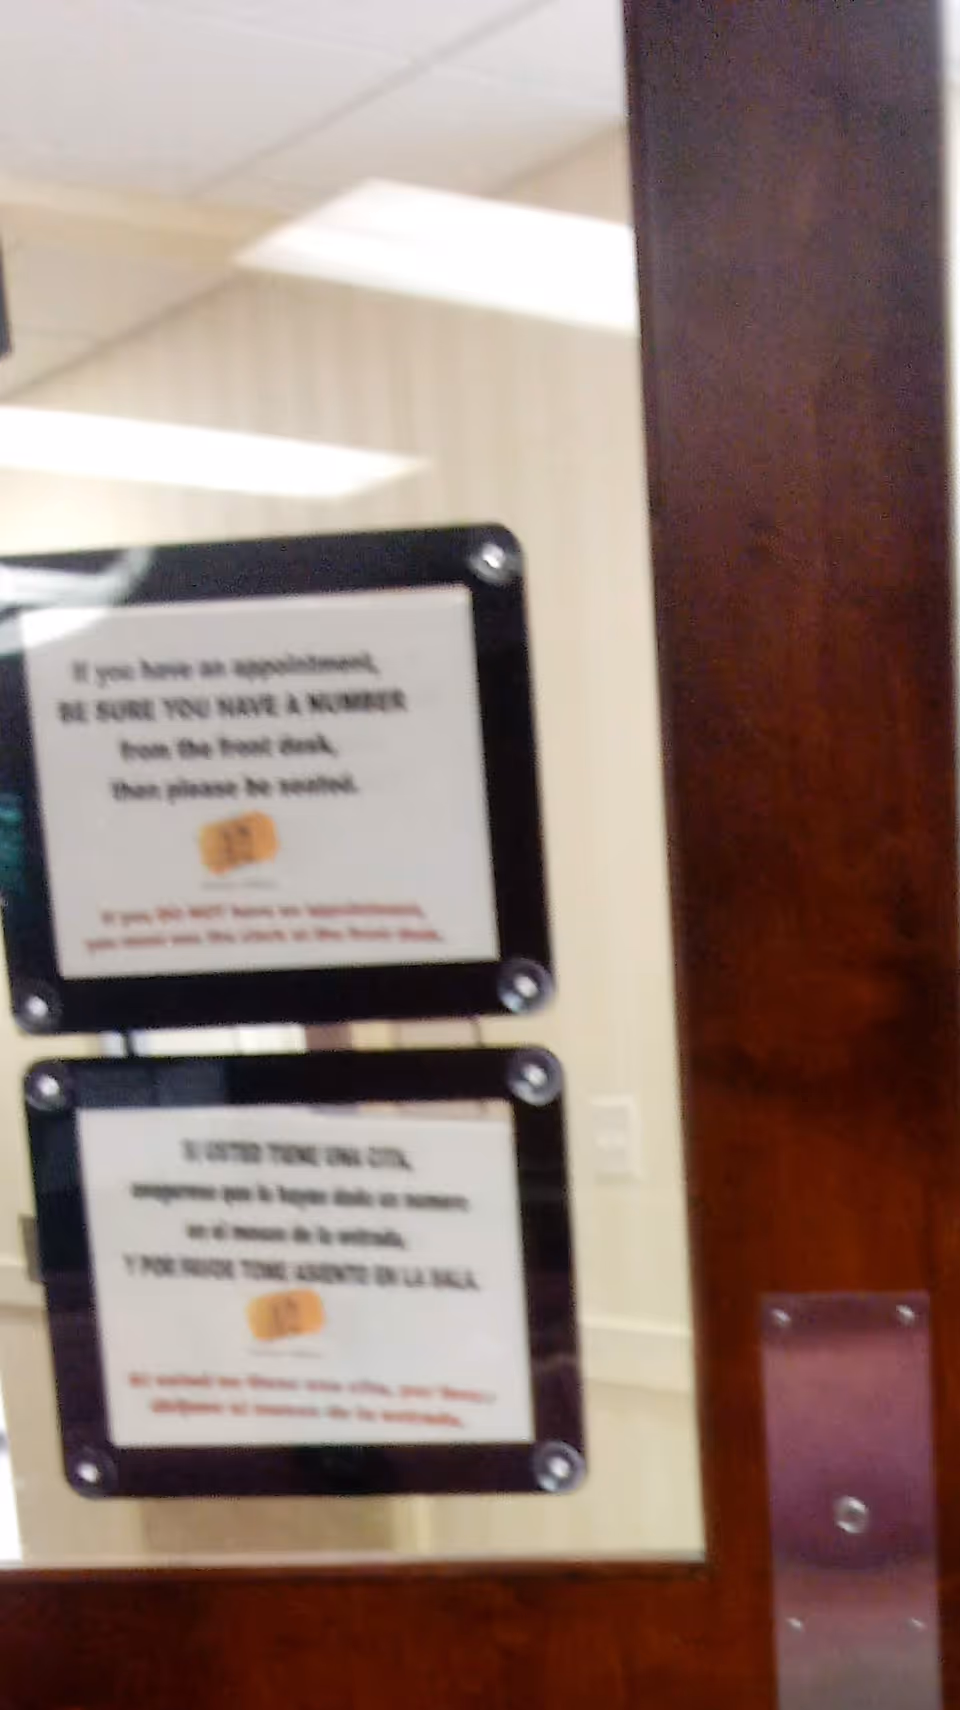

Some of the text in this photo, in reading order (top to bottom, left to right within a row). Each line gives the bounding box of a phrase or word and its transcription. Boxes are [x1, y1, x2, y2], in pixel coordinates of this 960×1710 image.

[96, 665, 134, 688] you
[138, 658, 192, 680] have
[200, 662, 226, 680] an
[231, 652, 380, 682] appointment,
[58, 688, 407, 724] BE SURE YOU HAVE A NUMBER
[120, 739, 171, 762] from
[176, 737, 212, 760] the
[217, 736, 272, 760] front
[112, 777, 161, 801] then
[166, 776, 239, 806] please
[243, 773, 271, 799] be
[183, 1139, 200, 1162] SI
[204, 1140, 262, 1165] USTED
[265, 1142, 320, 1168] TIENE
[324, 1144, 361, 1168] UNA
[223, 1186, 253, 1208] que
[333, 1189, 372, 1209] dado
[378, 1193, 400, 1209] un
[186, 1223, 208, 1241] en
[292, 1225, 312, 1244] de
[317, 1226, 333, 1245] la
[124, 1254, 137, 1277] Y
[141, 1256, 177, 1278] POR
[181, 1258, 234, 1281] FAVOR
[238, 1260, 287, 1282] TOME
[294, 1263, 370, 1286] ASIENTO
[373, 1265, 399, 1286] EN
[401, 1266, 426, 1288] LA
